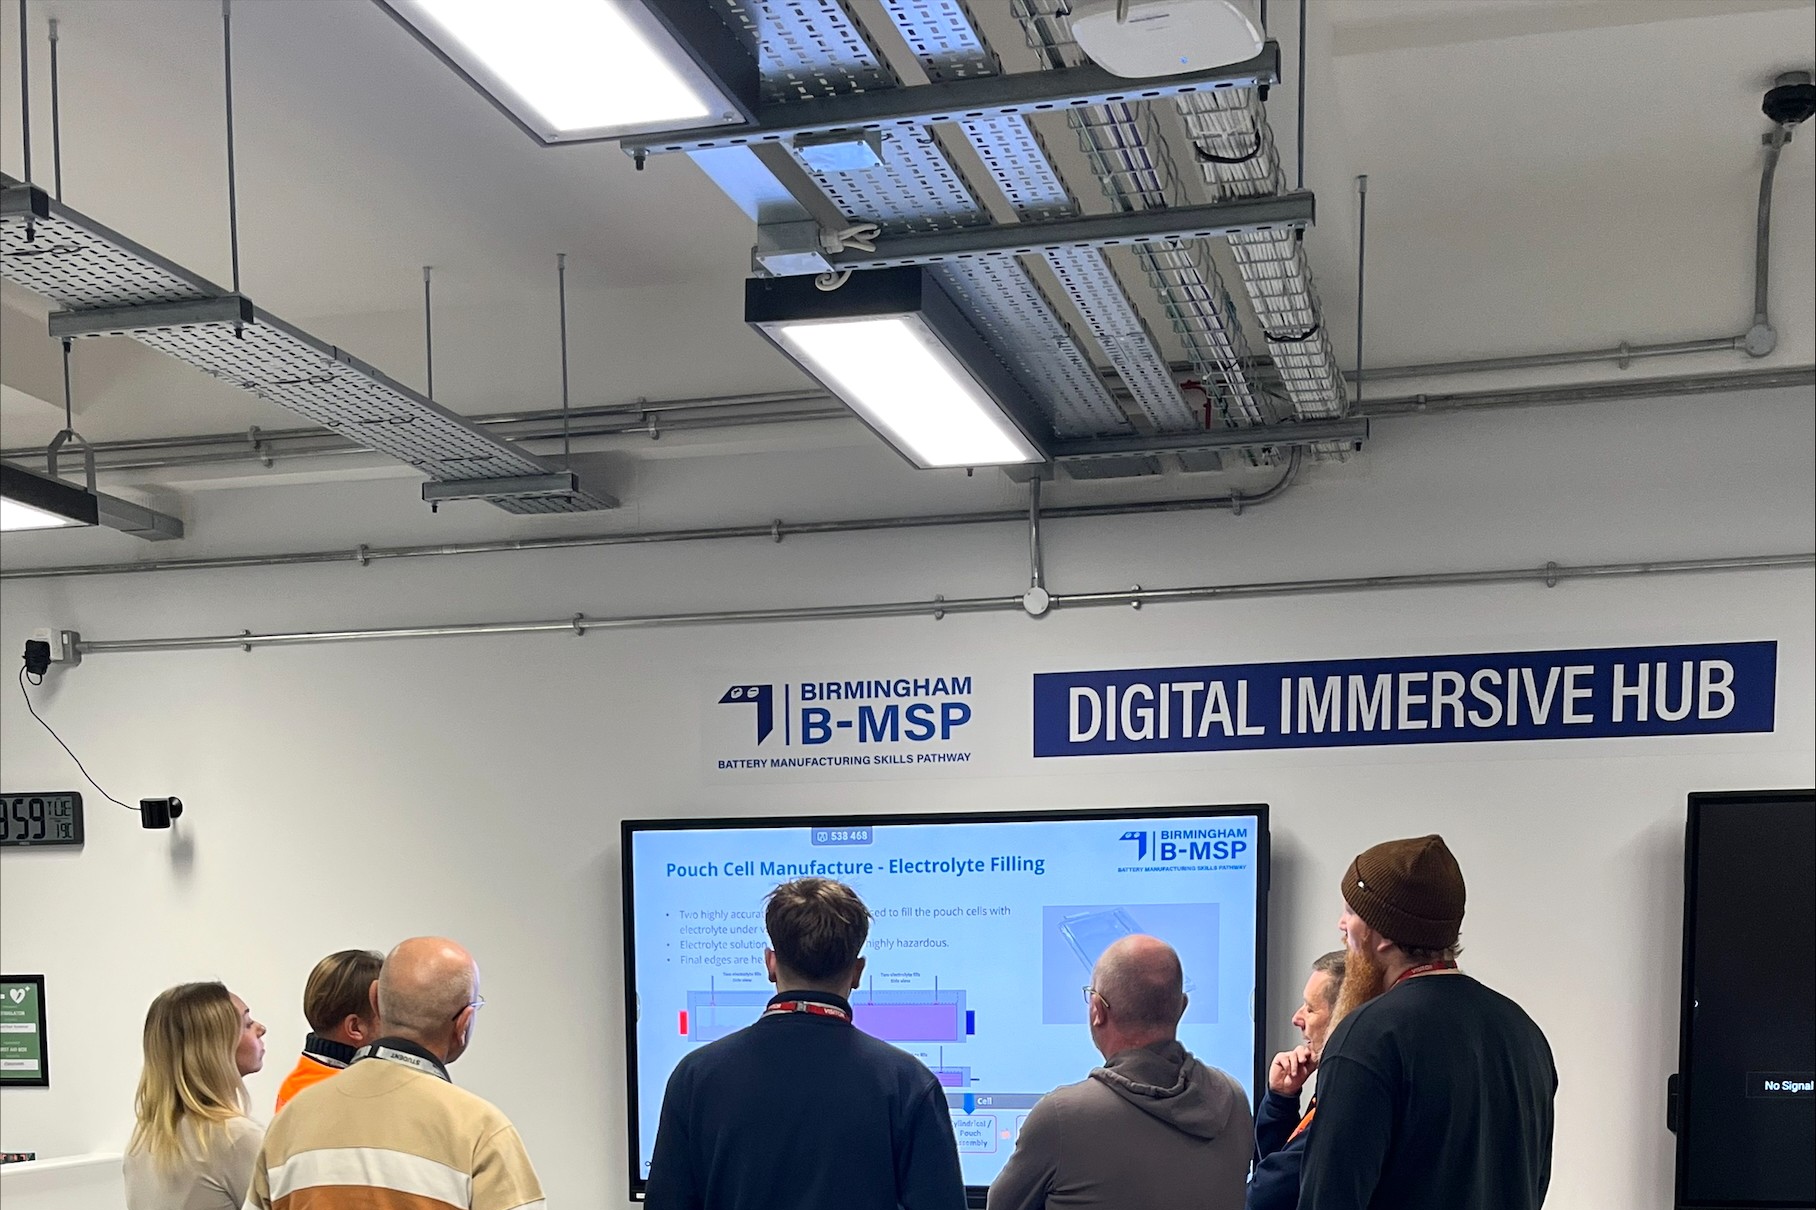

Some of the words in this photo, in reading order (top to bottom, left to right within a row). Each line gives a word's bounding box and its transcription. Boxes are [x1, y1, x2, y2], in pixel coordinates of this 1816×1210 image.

[801, 677, 972, 700] BIRMINGHAM
[1069, 679, 1265, 742] DIGITAL
[1280, 665, 1594, 734] IMMERSIVE
[1612, 659, 1735, 723] HUB
[801, 702, 972, 745] B-MSP
[718, 759, 768, 769] BATTERY
[770, 756, 871, 768] MANUFACTURING
[873, 754, 914, 764] SKILLS
[917, 753, 972, 763] PATHWAY
[831, 831, 848, 840] 538
[850, 830, 868, 840] 468
[1161, 828, 1248, 840] BIRMINGHAM
[1161, 841, 1247, 861] B-MSP
[666, 861, 718, 877] Pouch
[723, 861, 754, 876] Cell
[760, 860, 873, 876] Manufacture
[889, 857, 985, 877] Electrolyte
[991, 856, 1045, 875] Filling
[680, 910, 698, 920] Two
[700, 910, 728, 921] highly
[870, 907, 886, 918] sed
[889, 907, 899, 918] to
[901, 907, 912, 917] fill
[915, 906, 930, 917] the
[933, 906, 963, 918] pouch
[966, 906, 987, 916] cells
[990, 905, 1010, 916] with
[680, 924, 727, 936] electrolyte
[730, 924, 757, 934] under
[680, 940, 727, 951] Electrolyte
[897, 937, 949, 948] hazardous.
[680, 955, 702, 965] Final
[704, 955, 732, 967] edges
[734, 956, 748, 965] are
[751, 955, 763, 965] he
[391, 1053, 421, 1066] STUDENT
[1764, 1081, 1780, 1090] No
[1781, 1081, 1814, 1093] Signal
[977, 1096, 993, 1105] Cell
[953, 1120, 986, 1129] ylindrical
[958, 1139, 988, 1148] ssembly
